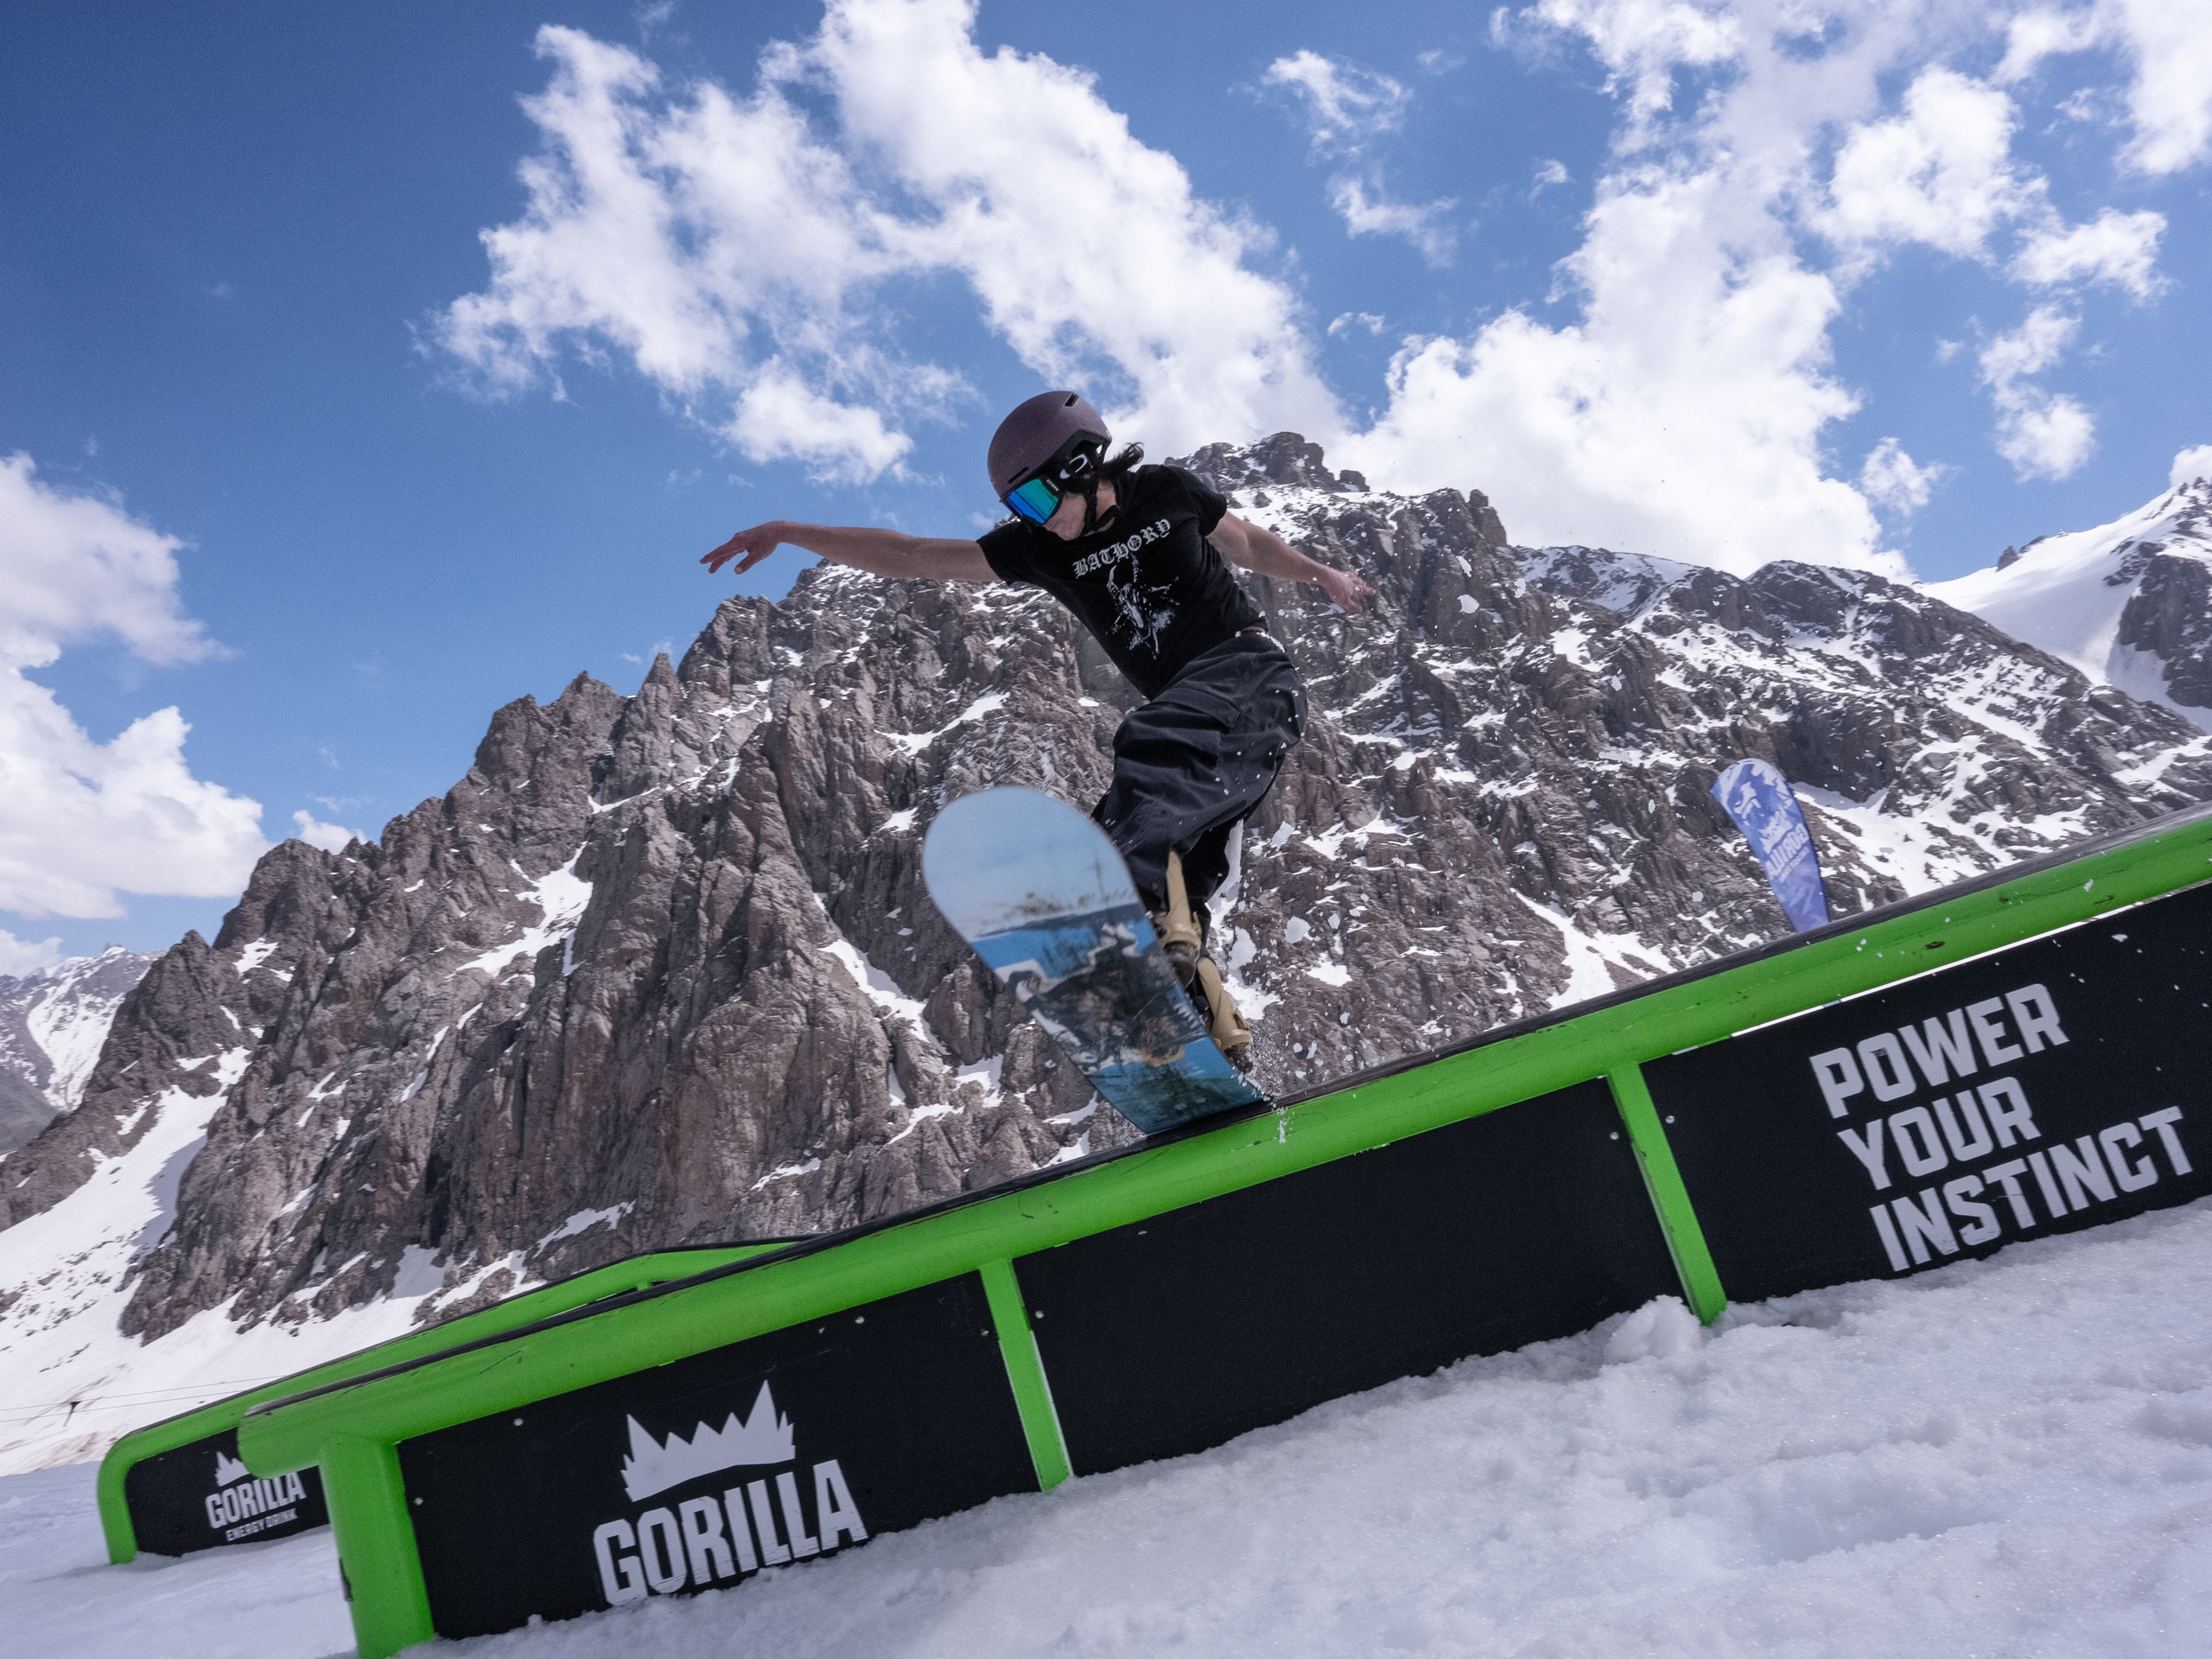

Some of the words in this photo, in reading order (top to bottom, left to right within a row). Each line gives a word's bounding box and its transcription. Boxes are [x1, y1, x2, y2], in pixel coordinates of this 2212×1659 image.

[1072, 518, 1171, 579] BATHORY
[1809, 983, 2070, 1119] POWER
[1836, 1077, 2042, 1191] YOUR
[1869, 1105, 2193, 1271] INSTINCT
[205, 1471, 307, 1529] GORILLA
[225, 1519, 265, 1541] ENERGY
[594, 1459, 869, 1606] GORILLA
